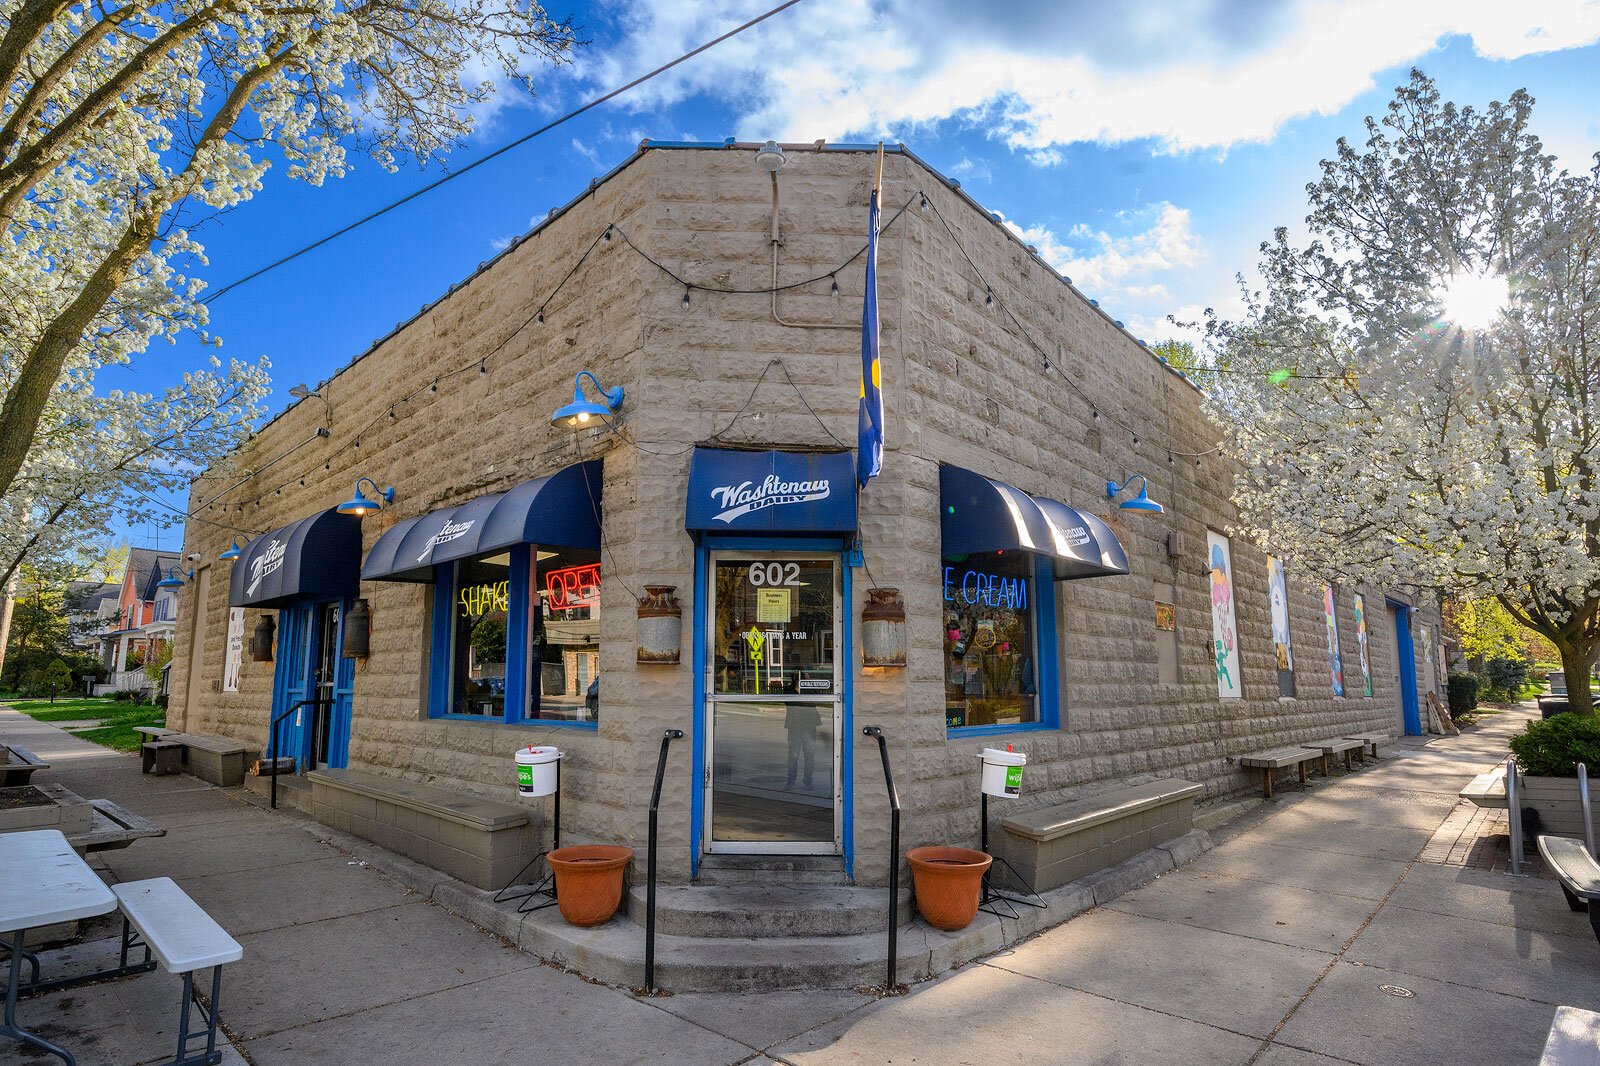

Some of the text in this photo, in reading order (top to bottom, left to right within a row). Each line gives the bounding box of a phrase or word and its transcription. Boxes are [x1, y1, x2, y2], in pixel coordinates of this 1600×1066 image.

[711, 474, 829, 508] Washtenaw
[749, 495, 806, 510] DAIRY
[749, 562, 800, 586] 602
[963, 570, 1027, 609] CREAM
[785, 631, 791, 640] A
[792, 631, 807, 640] YEAR
